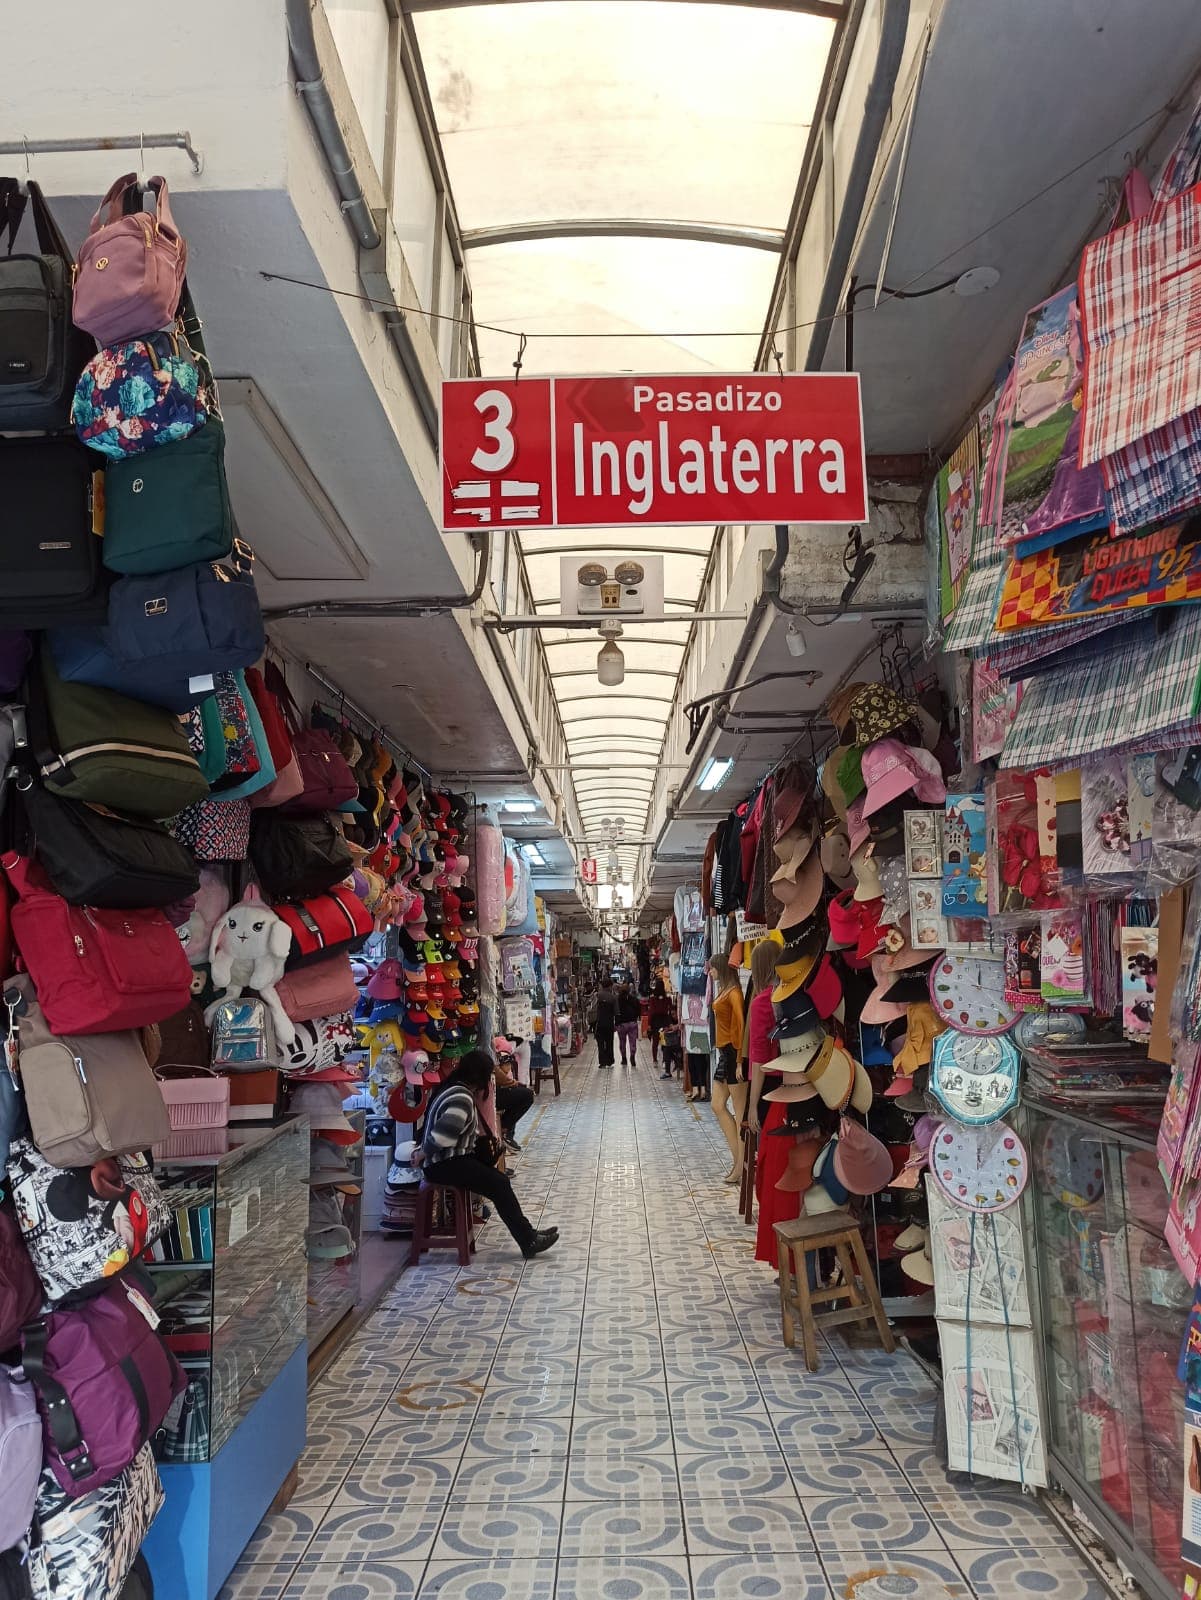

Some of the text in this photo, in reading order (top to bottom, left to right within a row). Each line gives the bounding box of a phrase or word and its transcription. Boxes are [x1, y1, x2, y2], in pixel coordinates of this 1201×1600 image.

[633, 385, 782, 413] Pasadizo
[470, 389, 515, 472] 3
[573, 420, 847, 515] Inglaterra
[1083, 525, 1181, 576] LIGHTNING
[1090, 542, 1197, 602] QUEEN 95
